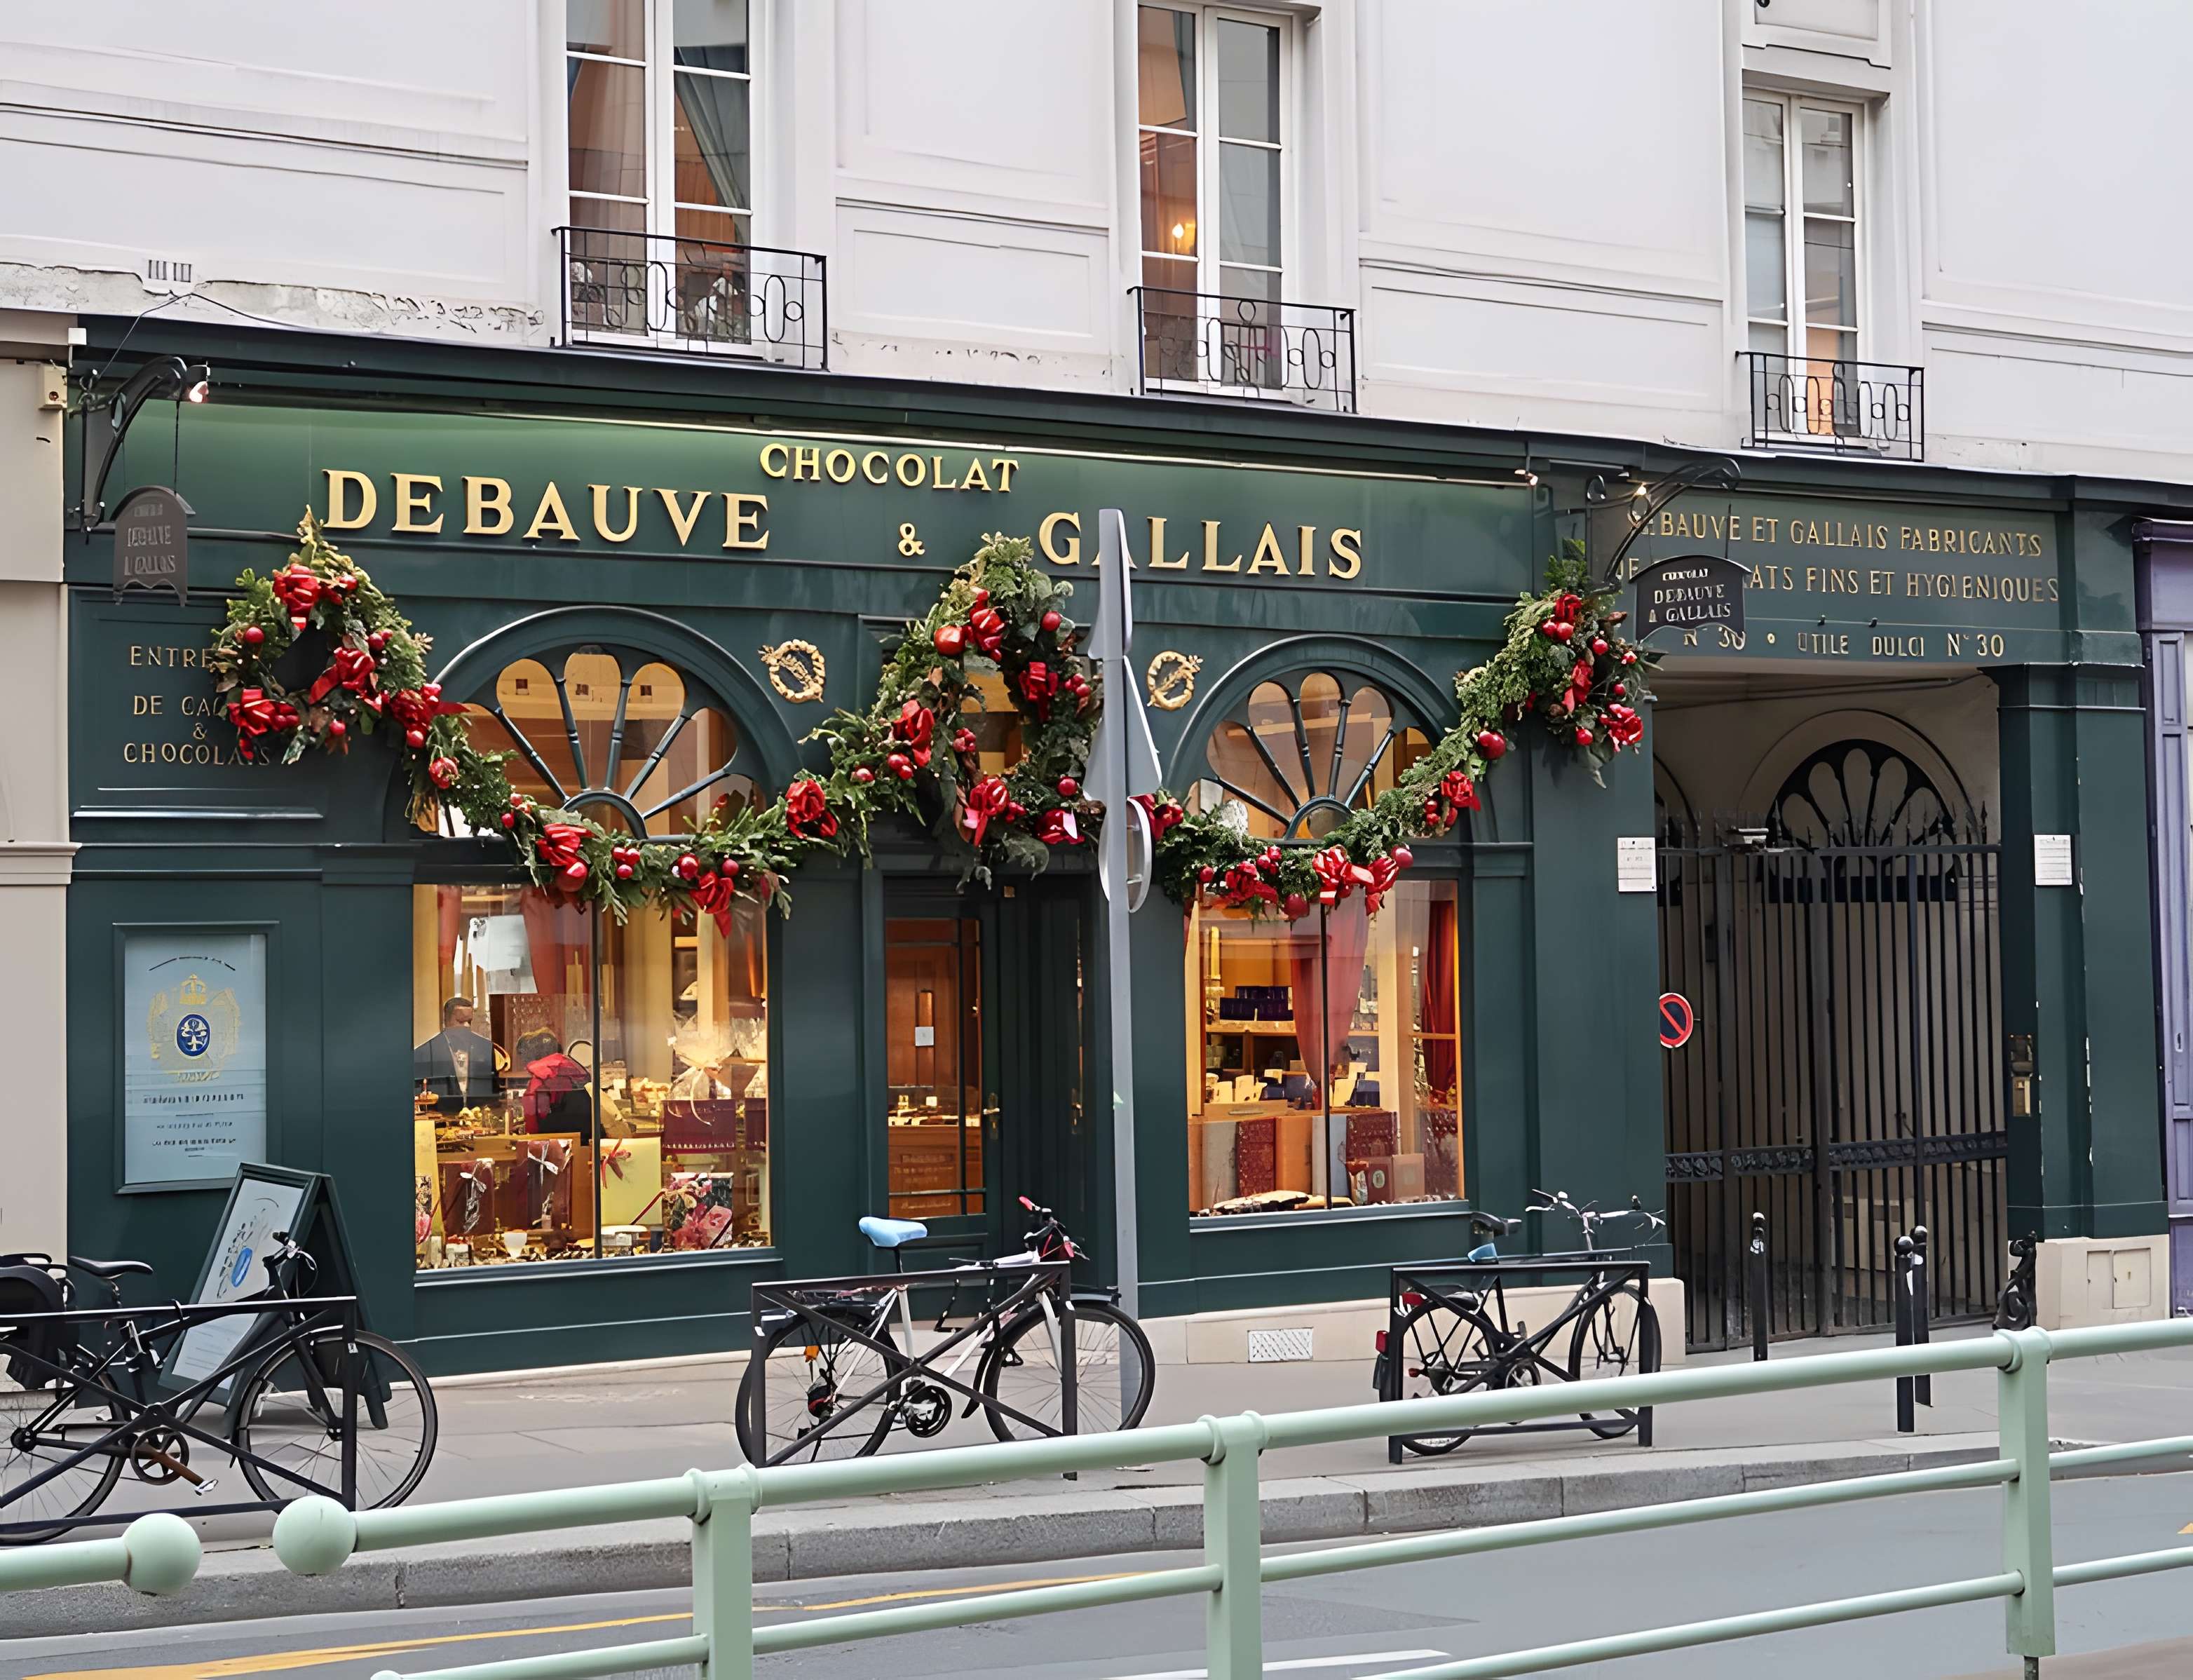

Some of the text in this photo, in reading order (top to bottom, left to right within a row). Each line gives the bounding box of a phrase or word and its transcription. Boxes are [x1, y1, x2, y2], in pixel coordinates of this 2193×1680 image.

[760, 443, 1019, 492] CHOCOLAT
[322, 468, 1362, 579] DEBAUVE & GLLAIS
[1641, 511, 2042, 557] EBAUVE ET GALLAIS FABRICANTS
[1805, 567, 1859, 594] FINS
[1870, 570, 1896, 595] ET
[130, 646, 214, 668] ENTRE
[1977, 634, 2004, 657] 30
[134, 695, 163, 715] DE
[193, 722, 207, 740] &
[124, 743, 270, 766] CHOCOLAS
